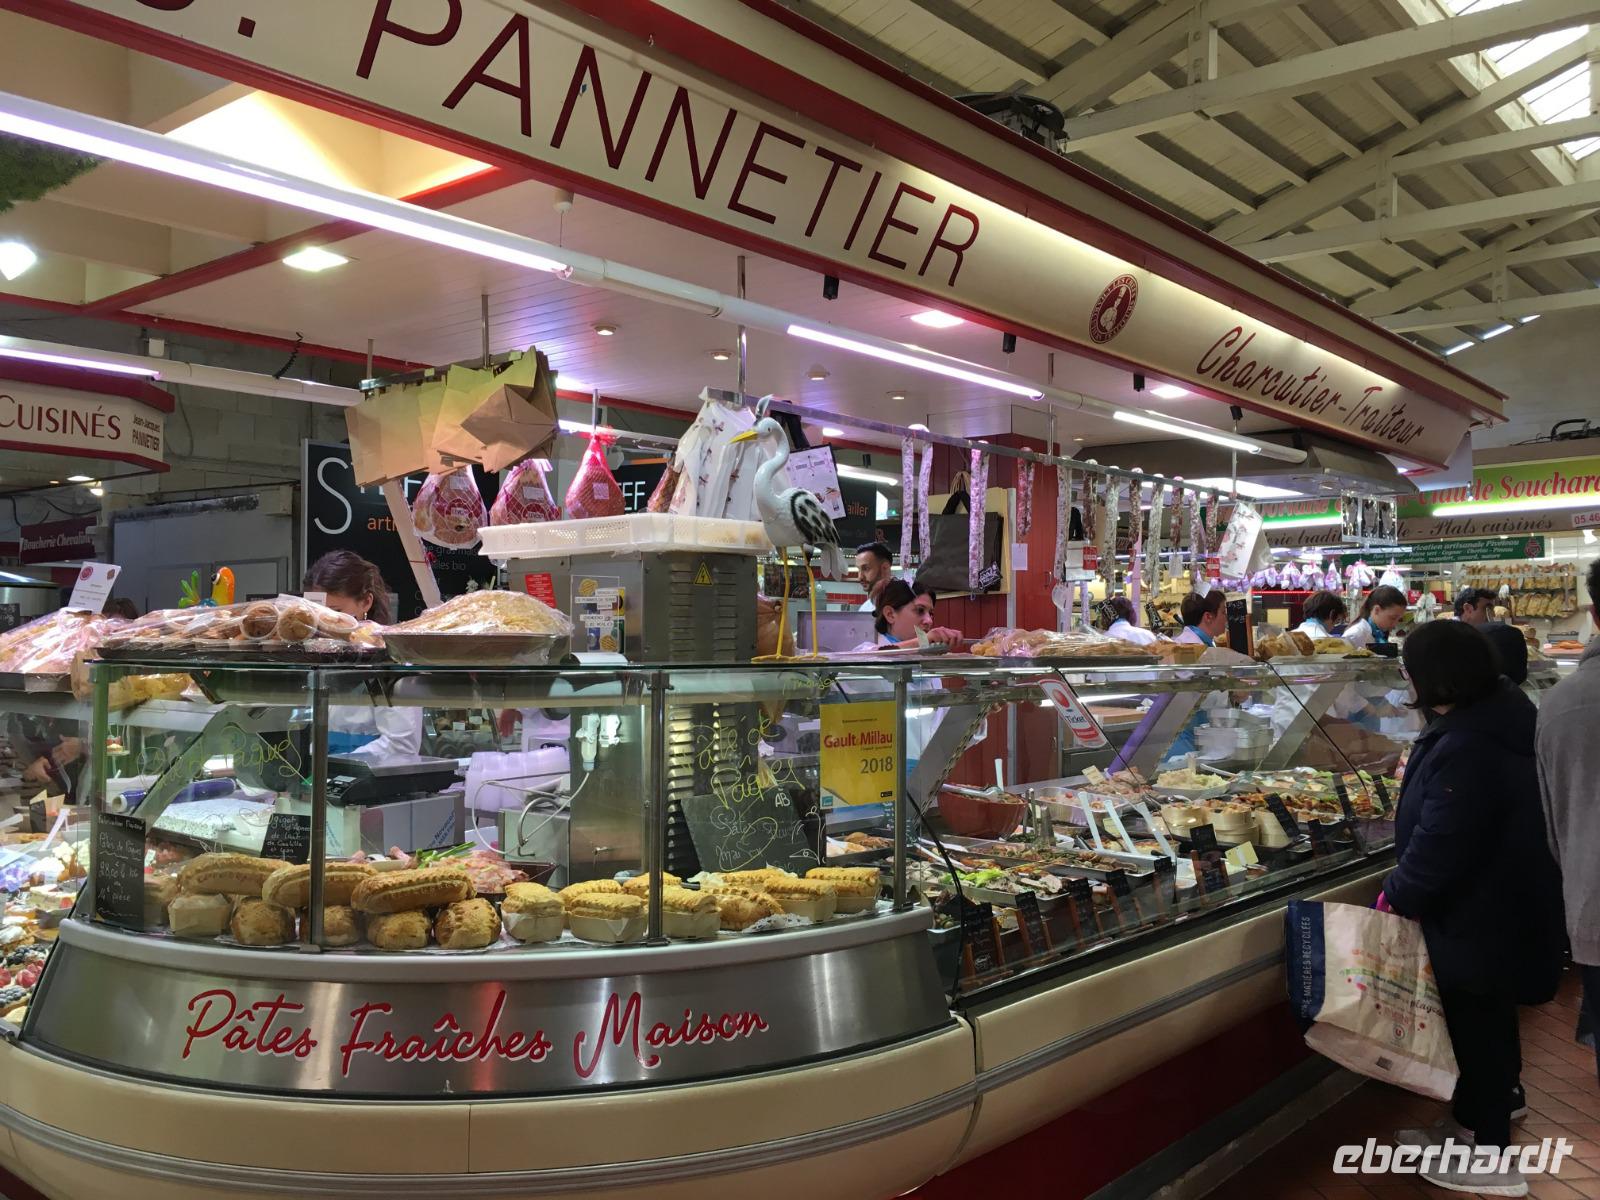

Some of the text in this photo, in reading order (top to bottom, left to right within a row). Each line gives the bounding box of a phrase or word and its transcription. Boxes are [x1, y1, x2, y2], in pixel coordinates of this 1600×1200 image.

[356, 0, 981, 286] PANNETIER
[1196, 326, 1426, 446] Charcutier-Traiteur
[859, 730, 893, 746] Millau
[860, 757, 893, 774] 2018
[181, 988, 769, 1080] Pâtes Fraîches Maison
